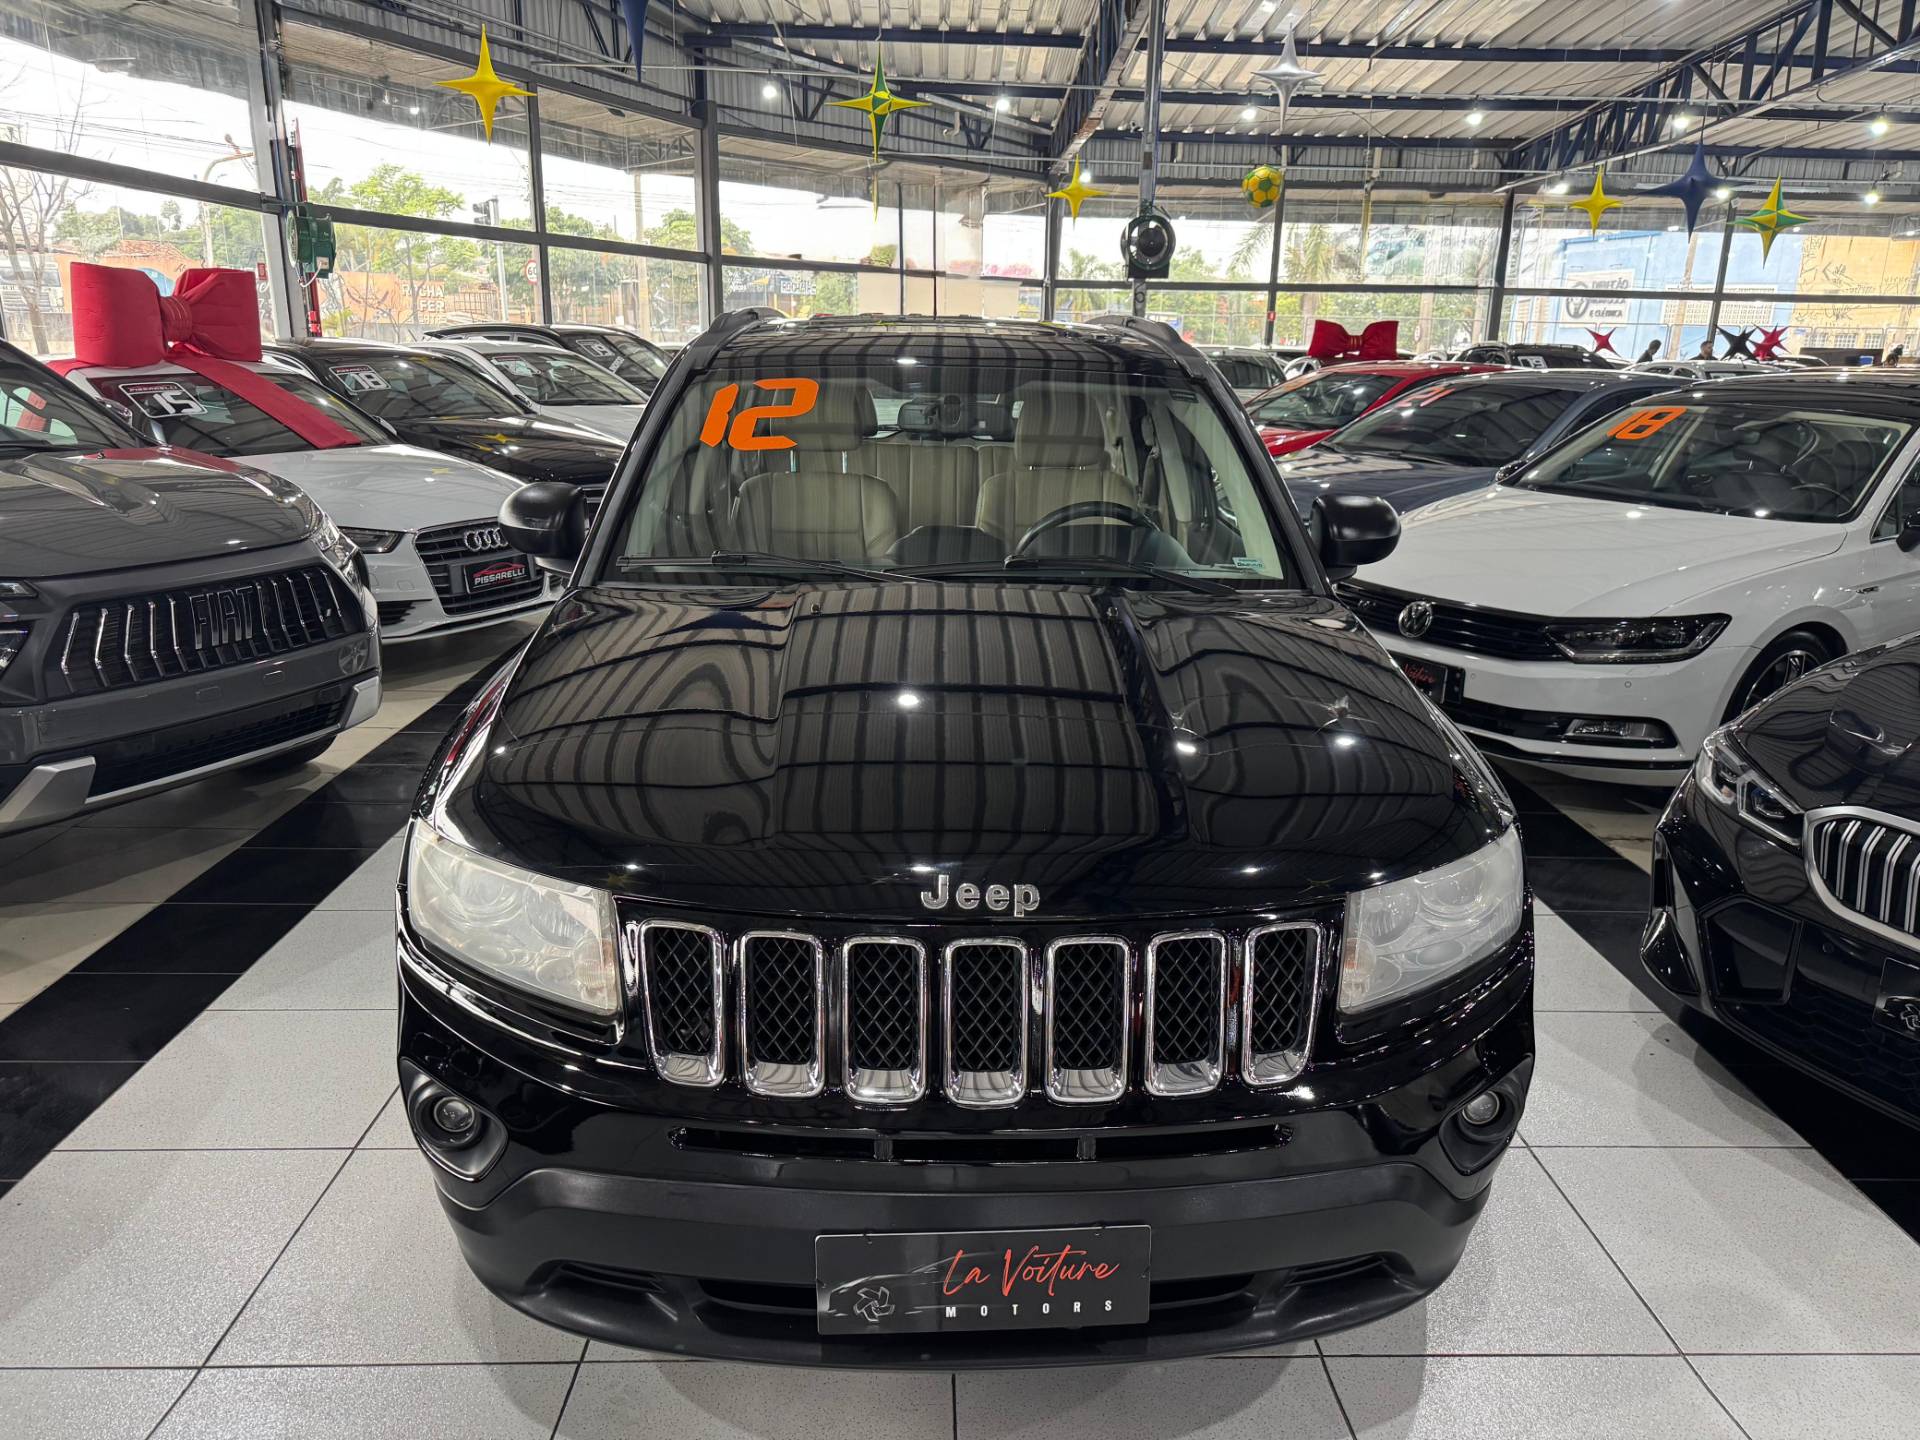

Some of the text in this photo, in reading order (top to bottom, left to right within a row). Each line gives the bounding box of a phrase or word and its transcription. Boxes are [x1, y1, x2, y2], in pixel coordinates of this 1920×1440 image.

[349, 373, 387, 389] 18
[153, 390, 202, 414] 15
[700, 378, 819, 451] 12
[1607, 407, 1687, 440] 18
[474, 567, 525, 585] PISSARELLI
[189, 585, 253, 650] FIAT
[921, 874, 1040, 917] Jeep
[943, 1244, 1119, 1297] La Voiture
[945, 1300, 1112, 1318] MOTORS
